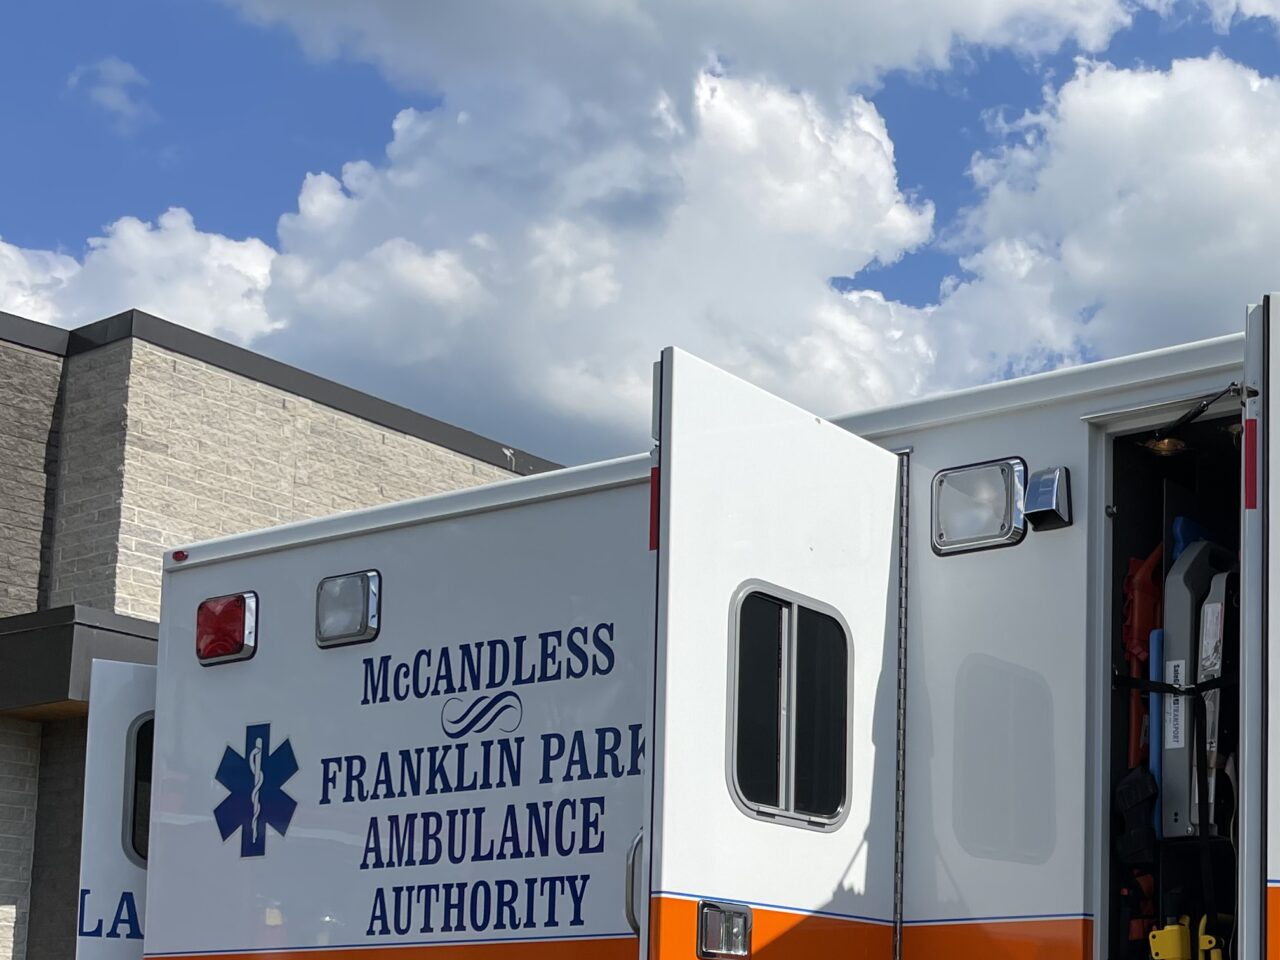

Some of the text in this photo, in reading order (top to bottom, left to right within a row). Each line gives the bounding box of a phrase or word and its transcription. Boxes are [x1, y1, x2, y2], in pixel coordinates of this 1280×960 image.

[361, 622, 615, 705] McCANDLESS
[1172, 704, 1181, 744] TRANSPORT
[319, 723, 646, 805] FRANKLIN PARK
[360, 796, 605, 870] AMBULANCE
[366, 874, 591, 936] AUTHORITY
